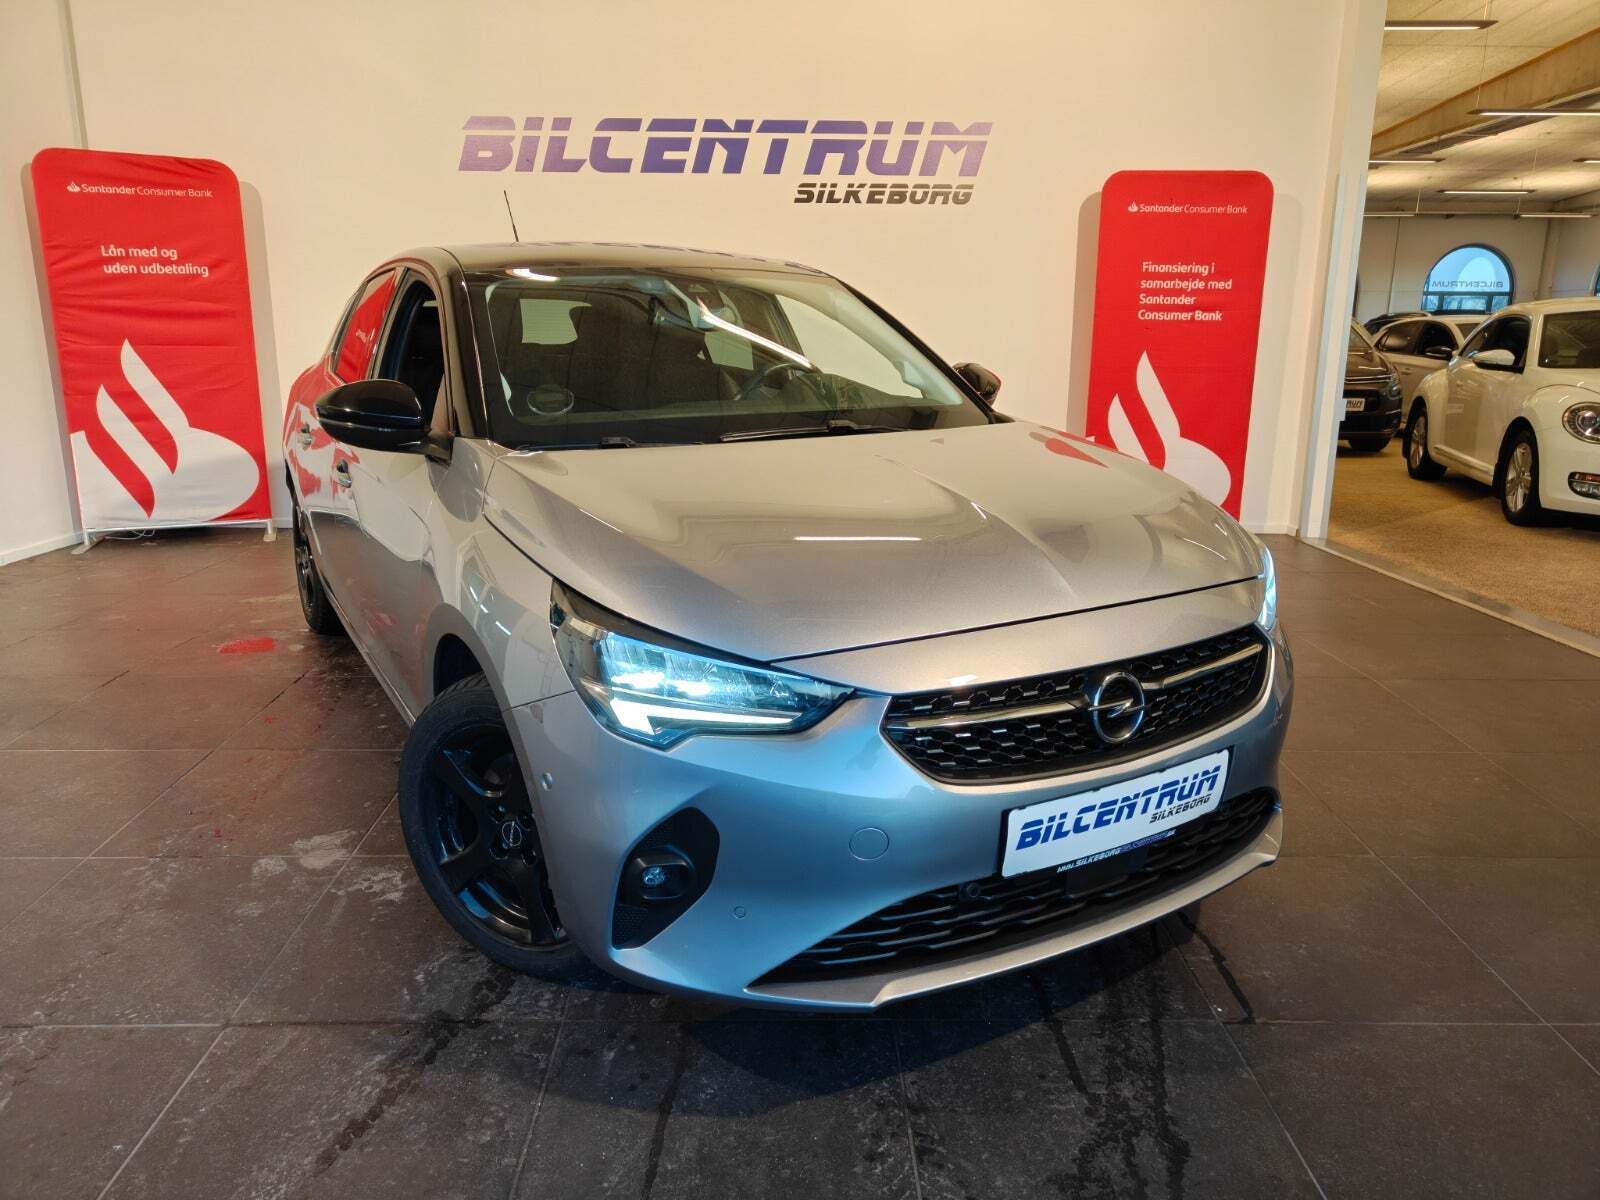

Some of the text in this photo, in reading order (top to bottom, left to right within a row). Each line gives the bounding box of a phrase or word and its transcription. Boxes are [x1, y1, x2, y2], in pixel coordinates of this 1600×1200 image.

[458, 115, 993, 177] BILCENTRUM
[81, 183, 213, 198] Santander Consumer Bank
[794, 183, 974, 205] SILKEBORG
[1139, 203, 1248, 214] Santander Consumer Bank
[101, 244, 178, 260] Lån med og
[103, 262, 209, 278] uden udbetaling
[1142, 261, 1216, 277] Finansiering i
[1140, 278, 1233, 292] samarbejde med
[1139, 293, 1197, 305] Santander
[1138, 309, 1223, 321] Consumer Bank
[1015, 764, 1222, 850] BILCENTRUM
[1149, 793, 1212, 824] SILKEBORG
